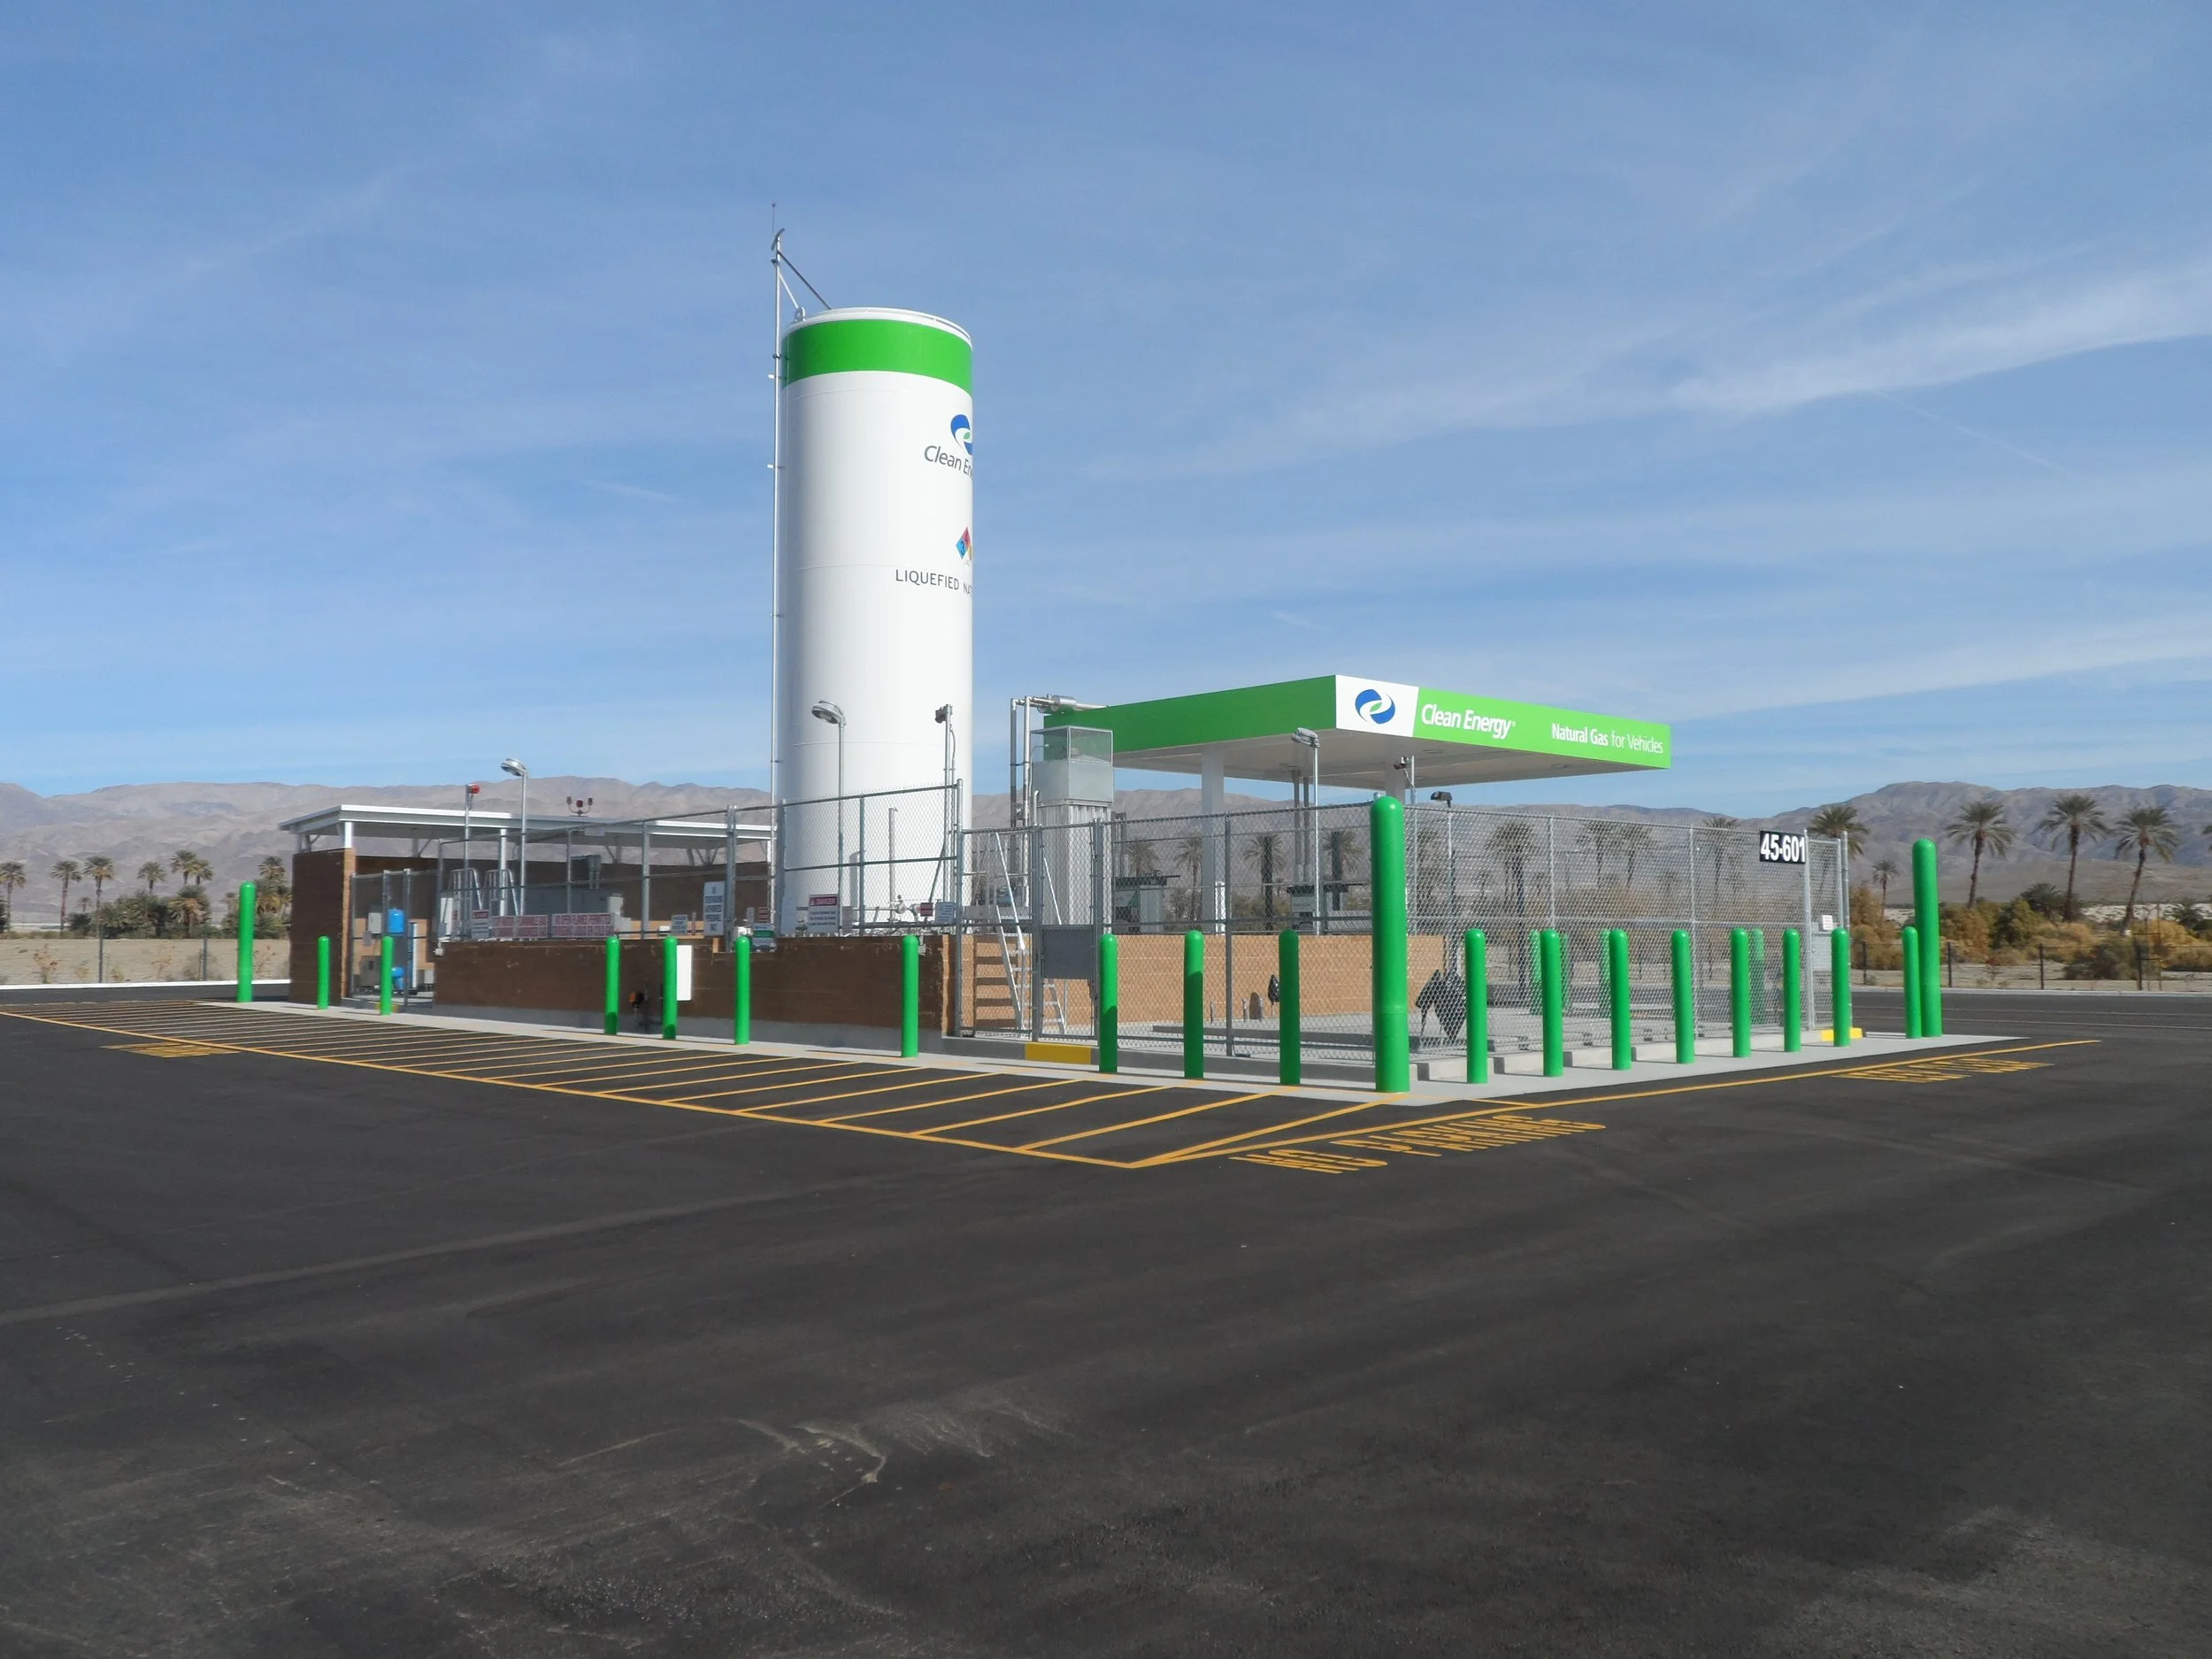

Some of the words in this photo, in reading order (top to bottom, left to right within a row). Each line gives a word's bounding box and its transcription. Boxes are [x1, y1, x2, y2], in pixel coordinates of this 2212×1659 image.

[924, 445, 962, 471] Clean
[895, 569, 959, 590] LIQUEFIED
[1421, 703, 1462, 728] Clean
[1463, 710, 1512, 740] Energy
[1552, 723, 1587, 743] Natural
[1590, 728, 1609, 747] Gas
[1610, 730, 1625, 749] for
[1627, 733, 1663, 754] Vehicles
[1760, 833, 1806, 863] 45-601
[1227, 1149, 1388, 1174] NO
[1329, 1115, 1607, 1157] PARKING
